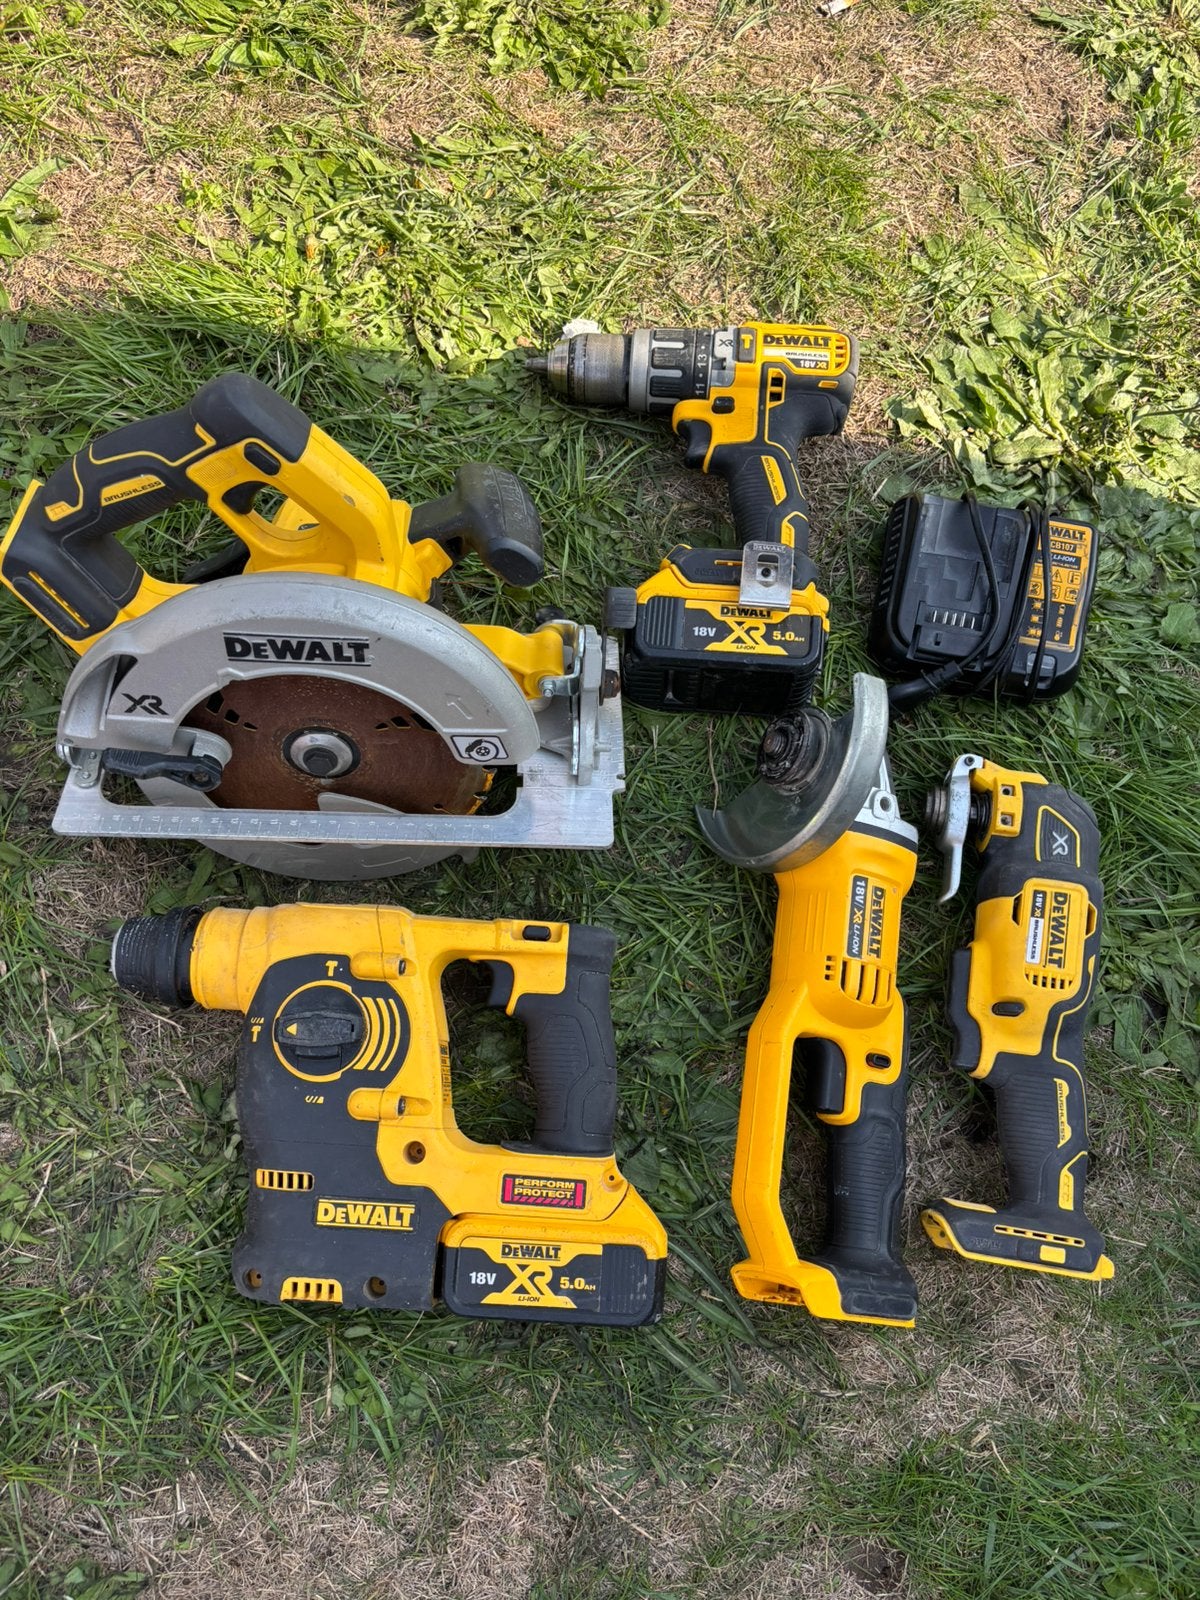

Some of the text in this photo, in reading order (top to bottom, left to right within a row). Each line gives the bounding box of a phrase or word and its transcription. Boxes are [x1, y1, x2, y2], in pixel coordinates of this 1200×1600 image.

[763, 335, 831, 347] DEWALT
[697, 353, 707, 367] 13
[800, 360, 815, 368] 18V
[104, 481, 162, 502] BRUSHLESS
[1050, 527, 1086, 541] WALT
[1050, 541, 1074, 551] CB107
[693, 627, 716, 637] 18V
[722, 620, 768, 646] XR
[223, 636, 369, 663] DEWALT
[121, 693, 168, 715] XR
[1052, 831, 1069, 856] XR
[1035, 893, 1043, 908] 18V
[869, 886, 886, 958] DEWALT
[1048, 891, 1068, 968] DEWALT
[1031, 919, 1039, 959] BRUSHLESS
[515, 1178, 575, 1189] PERFORM
[317, 1202, 415, 1227] DEWALT
[501, 1244, 561, 1259] DEWALT
[469, 1272, 497, 1285] 18V
[501, 1263, 556, 1296] XR
